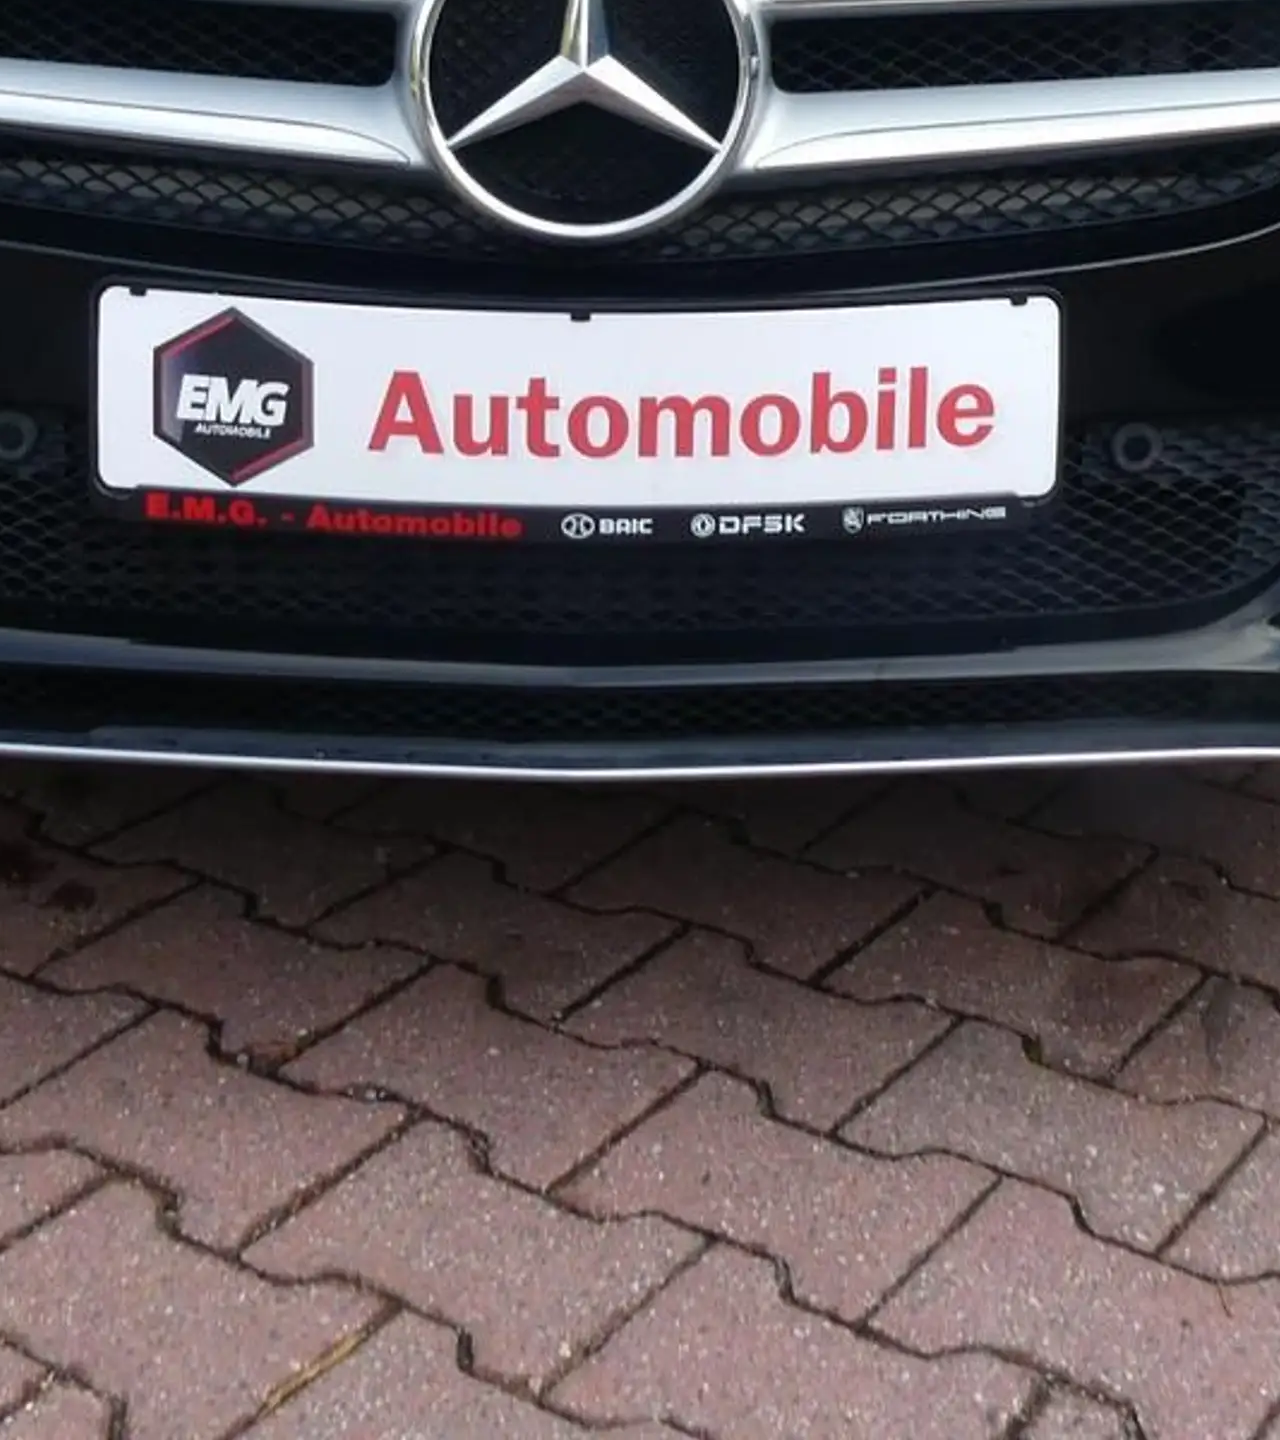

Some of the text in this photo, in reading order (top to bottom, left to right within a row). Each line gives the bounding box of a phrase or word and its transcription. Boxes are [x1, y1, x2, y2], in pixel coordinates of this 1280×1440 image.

[176, 373, 290, 426] EMG
[368, 366, 996, 459] Automobile
[144, 492, 268, 527] E.M.G.
[306, 504, 525, 539] Automobile
[719, 513, 807, 535] DFSK
